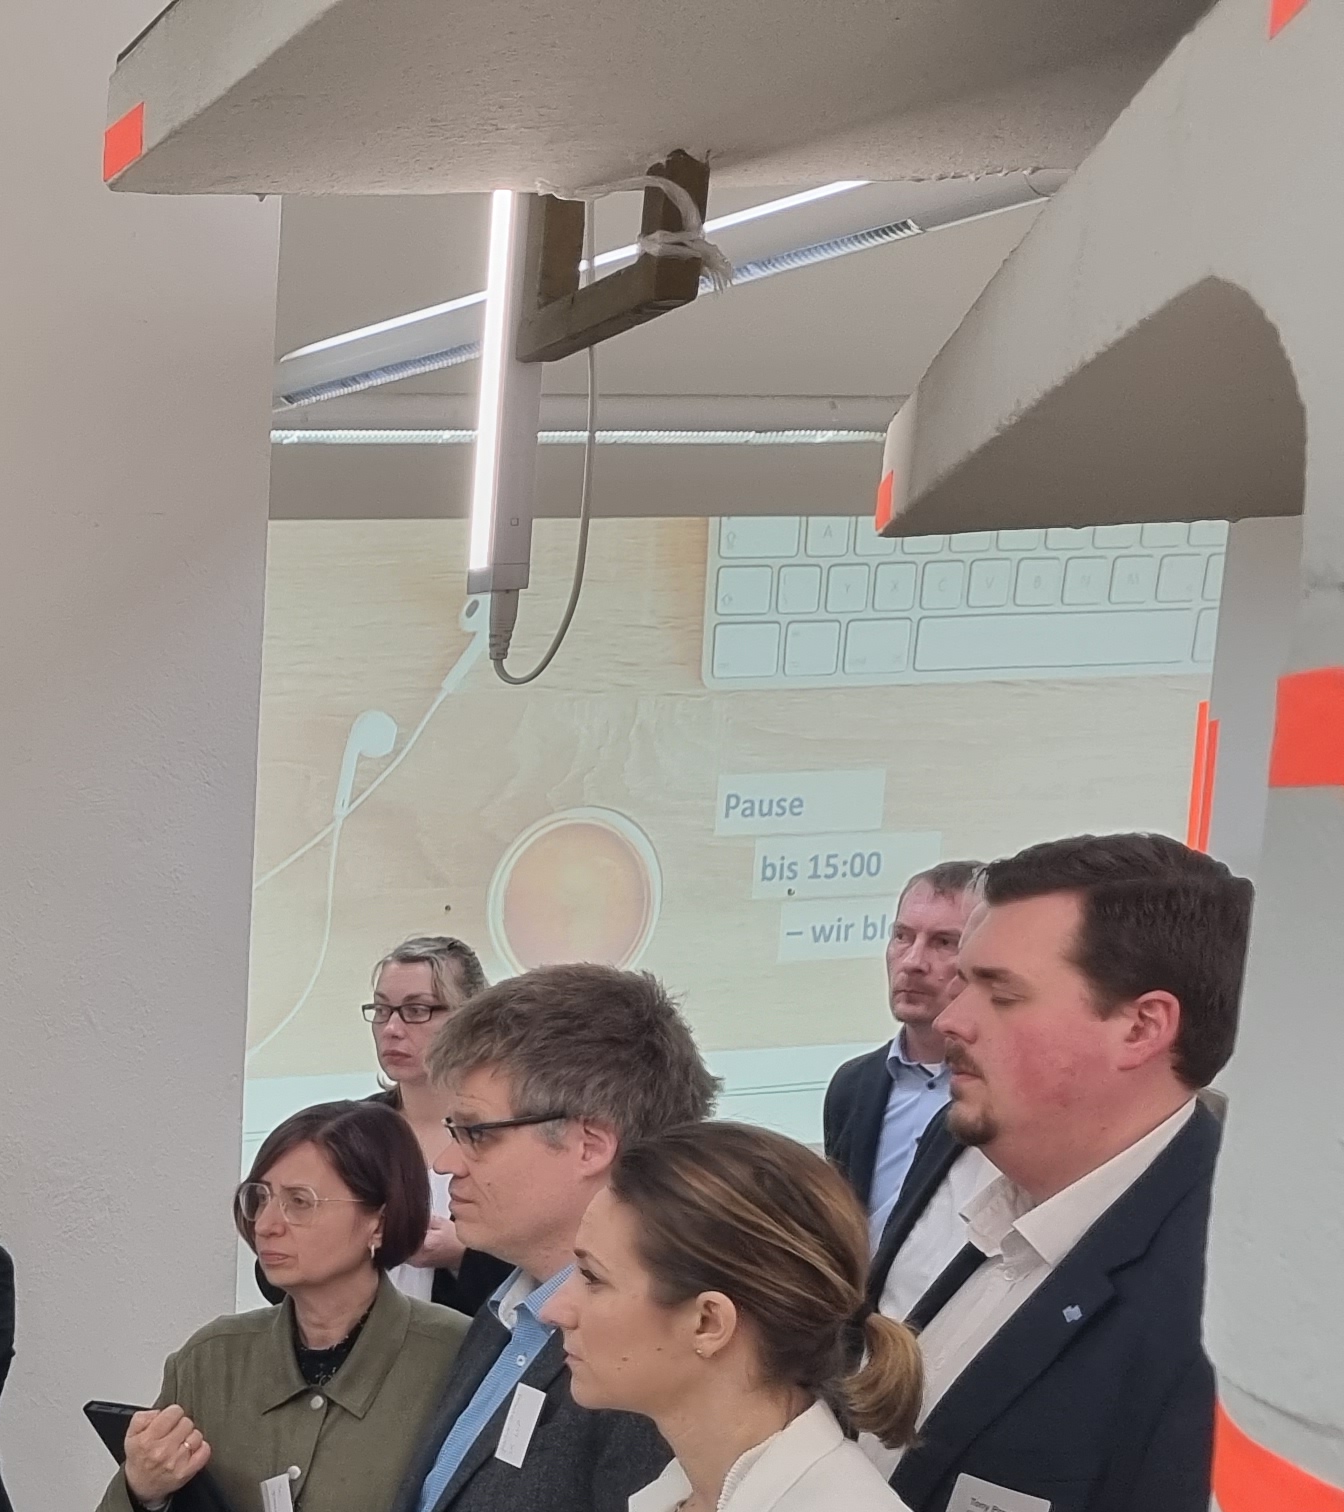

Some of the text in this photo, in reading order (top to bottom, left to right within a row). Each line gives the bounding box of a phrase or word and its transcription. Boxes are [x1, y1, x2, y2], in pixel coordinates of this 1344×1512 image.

[723, 791, 805, 819] Pause
[760, 850, 883, 882] bis 15:00
[811, 915, 854, 944] wir
